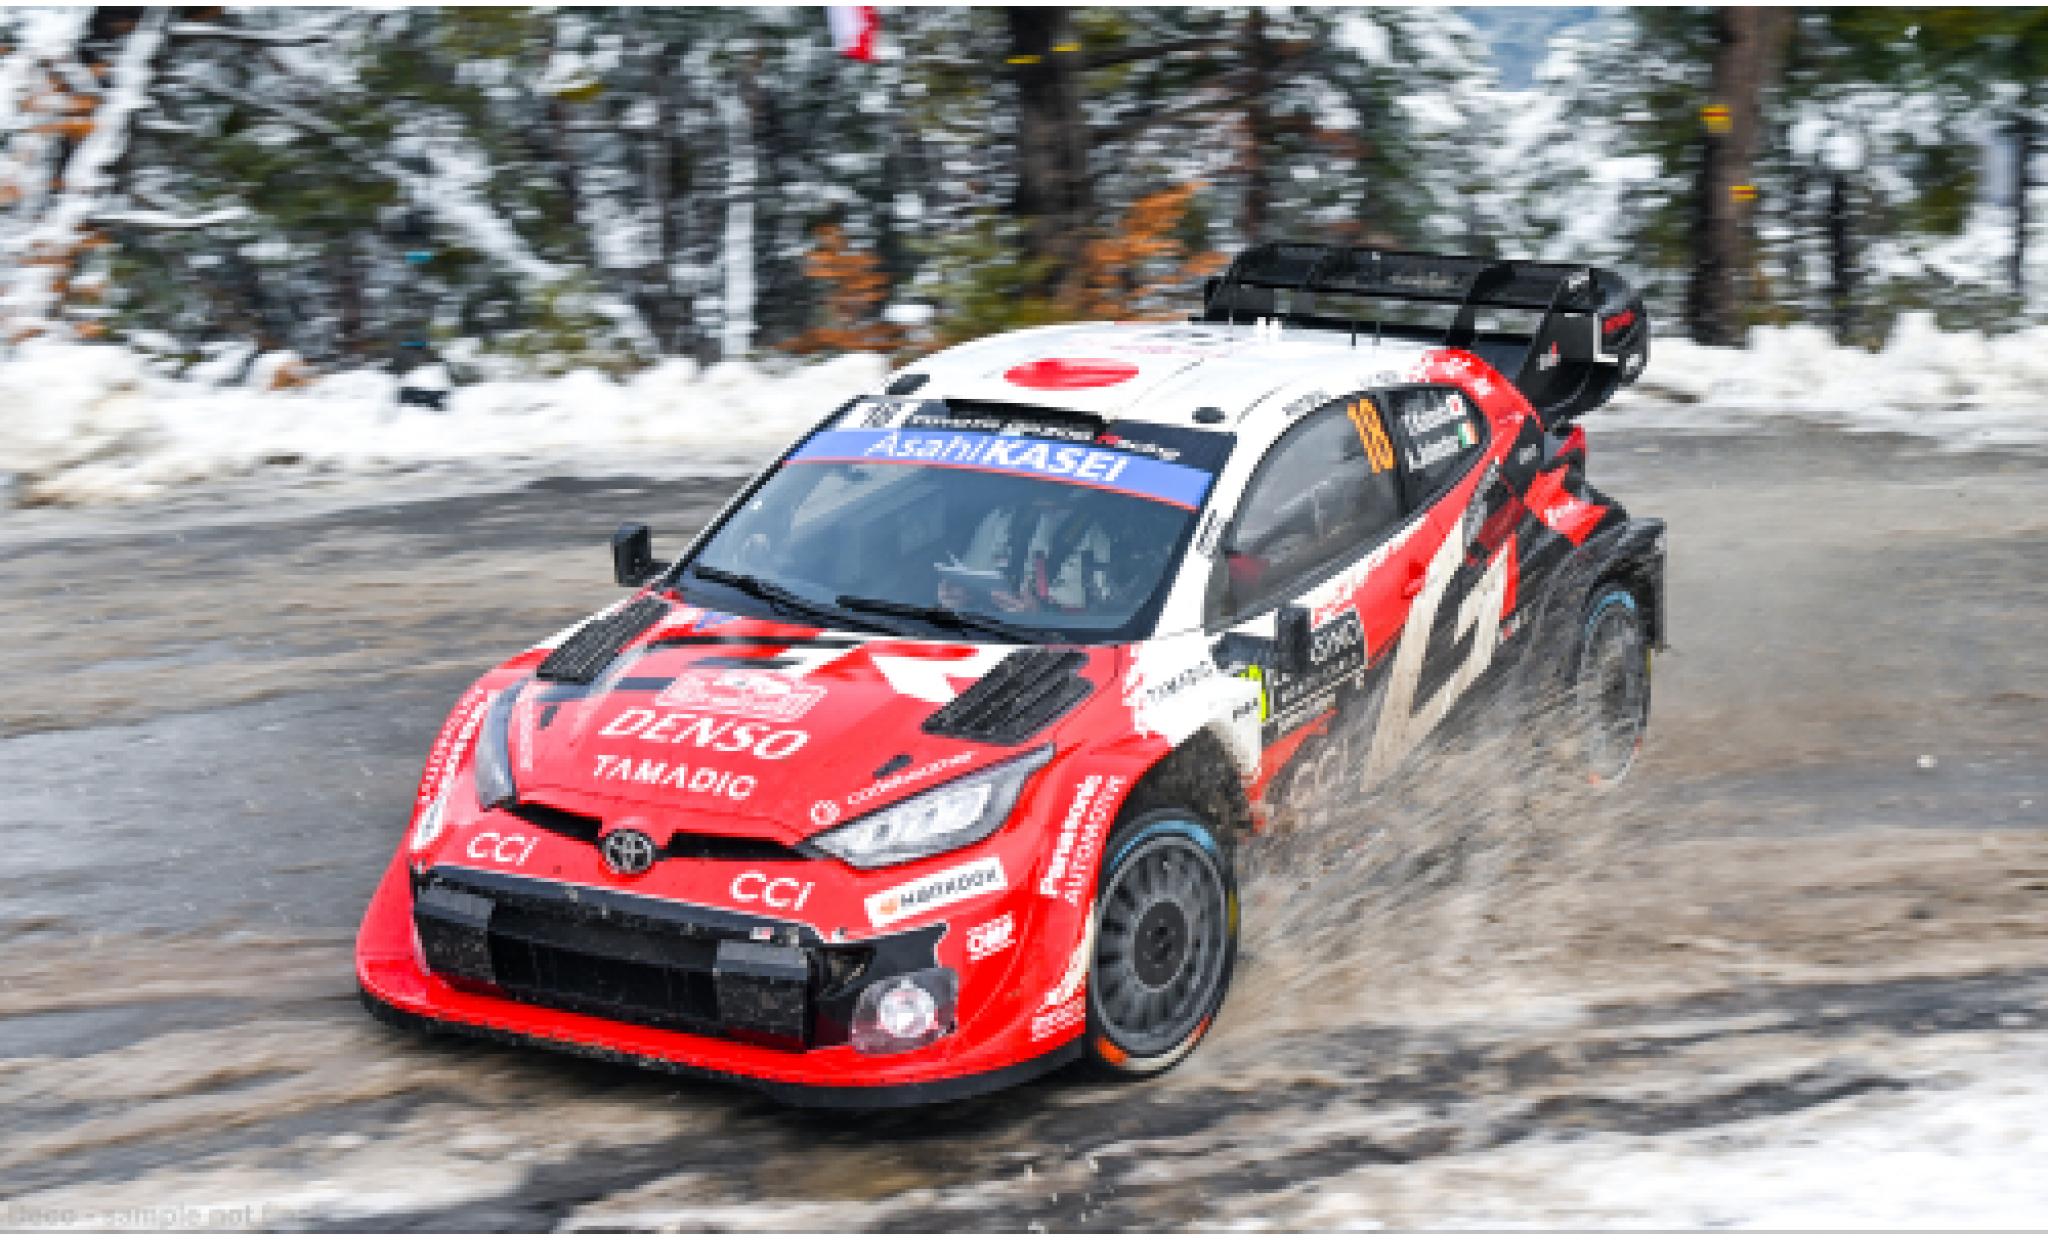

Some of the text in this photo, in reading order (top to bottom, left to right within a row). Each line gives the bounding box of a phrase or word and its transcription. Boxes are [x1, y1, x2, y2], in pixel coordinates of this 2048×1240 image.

[598, 706, 809, 761] DENSO
[466, 831, 540, 866] CCI
[730, 870, 815, 911] CCI
